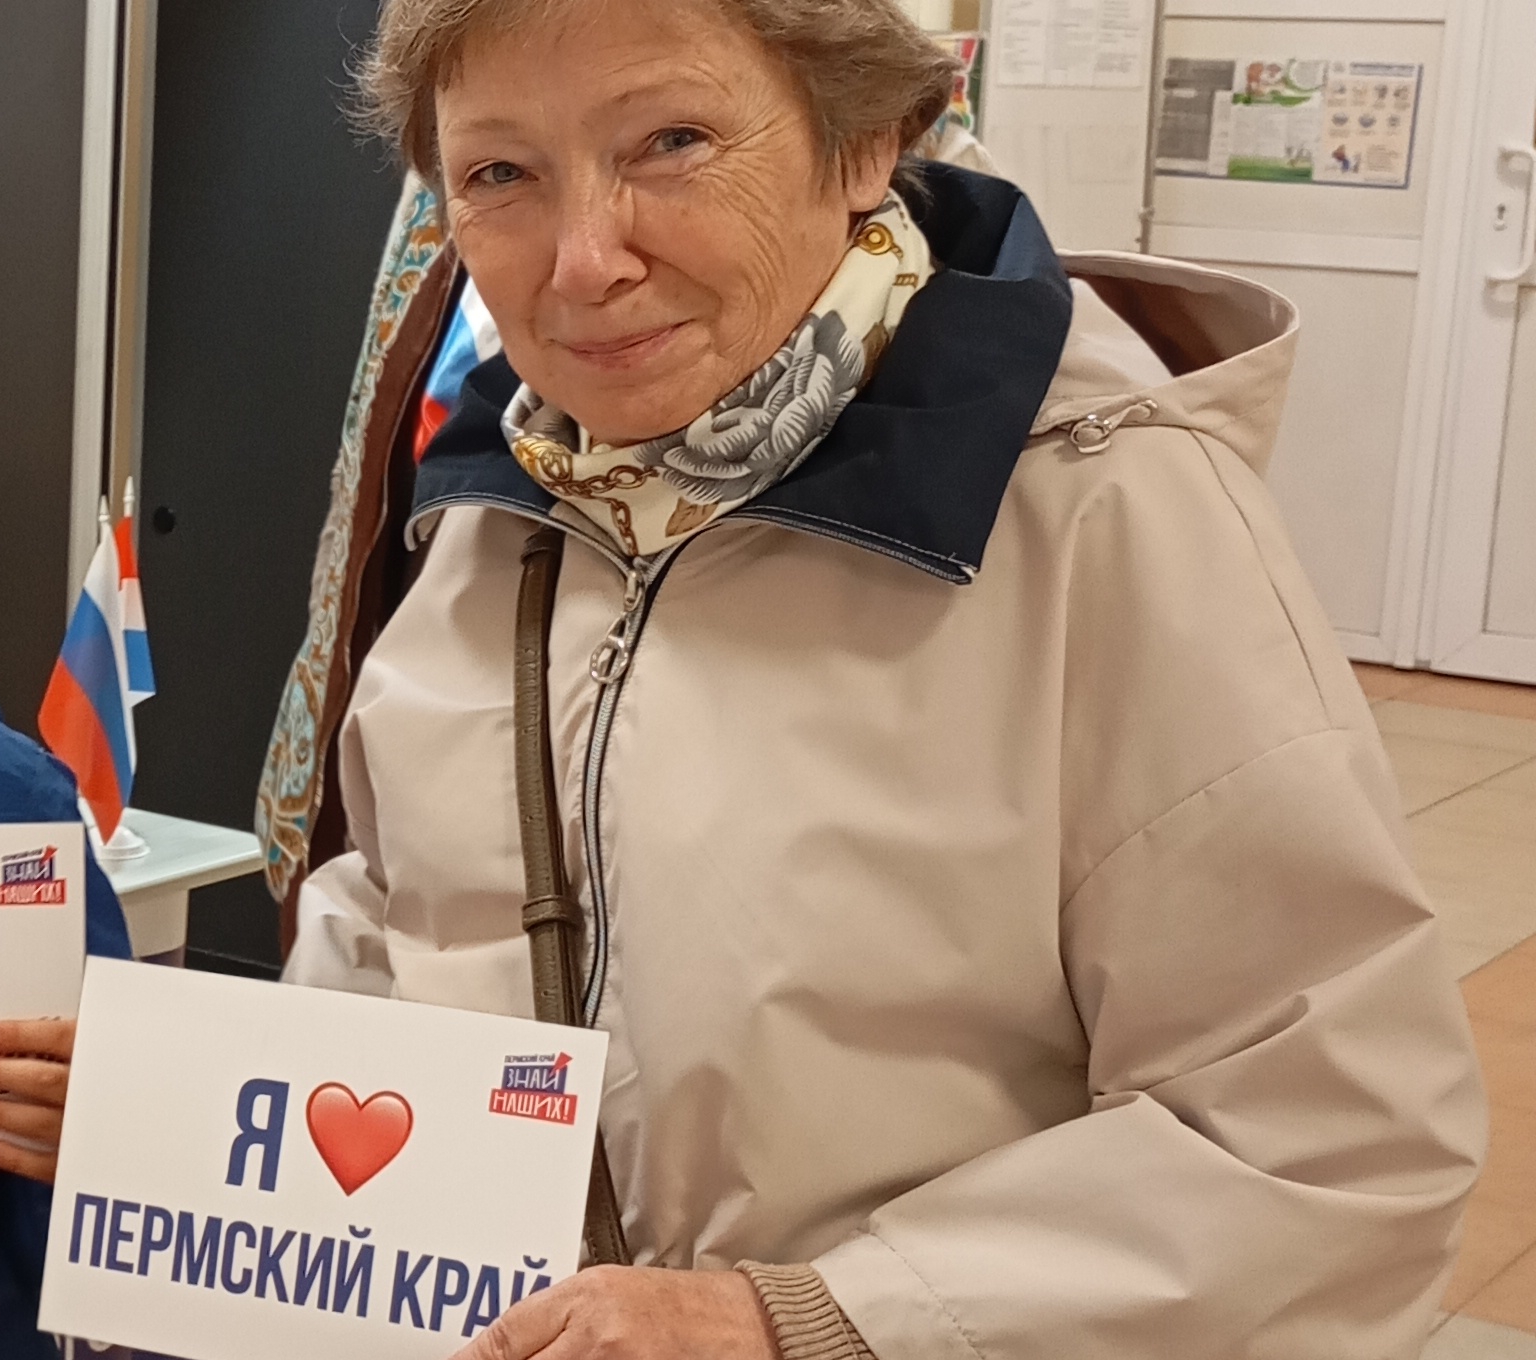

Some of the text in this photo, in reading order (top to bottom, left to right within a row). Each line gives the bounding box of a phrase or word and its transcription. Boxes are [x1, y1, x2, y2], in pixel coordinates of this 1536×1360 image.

[225, 1078, 289, 1192] Я
[492, 1090, 572, 1122] НАШИХ!
[68, 1192, 375, 1319] ПЕРМСКИЙ
